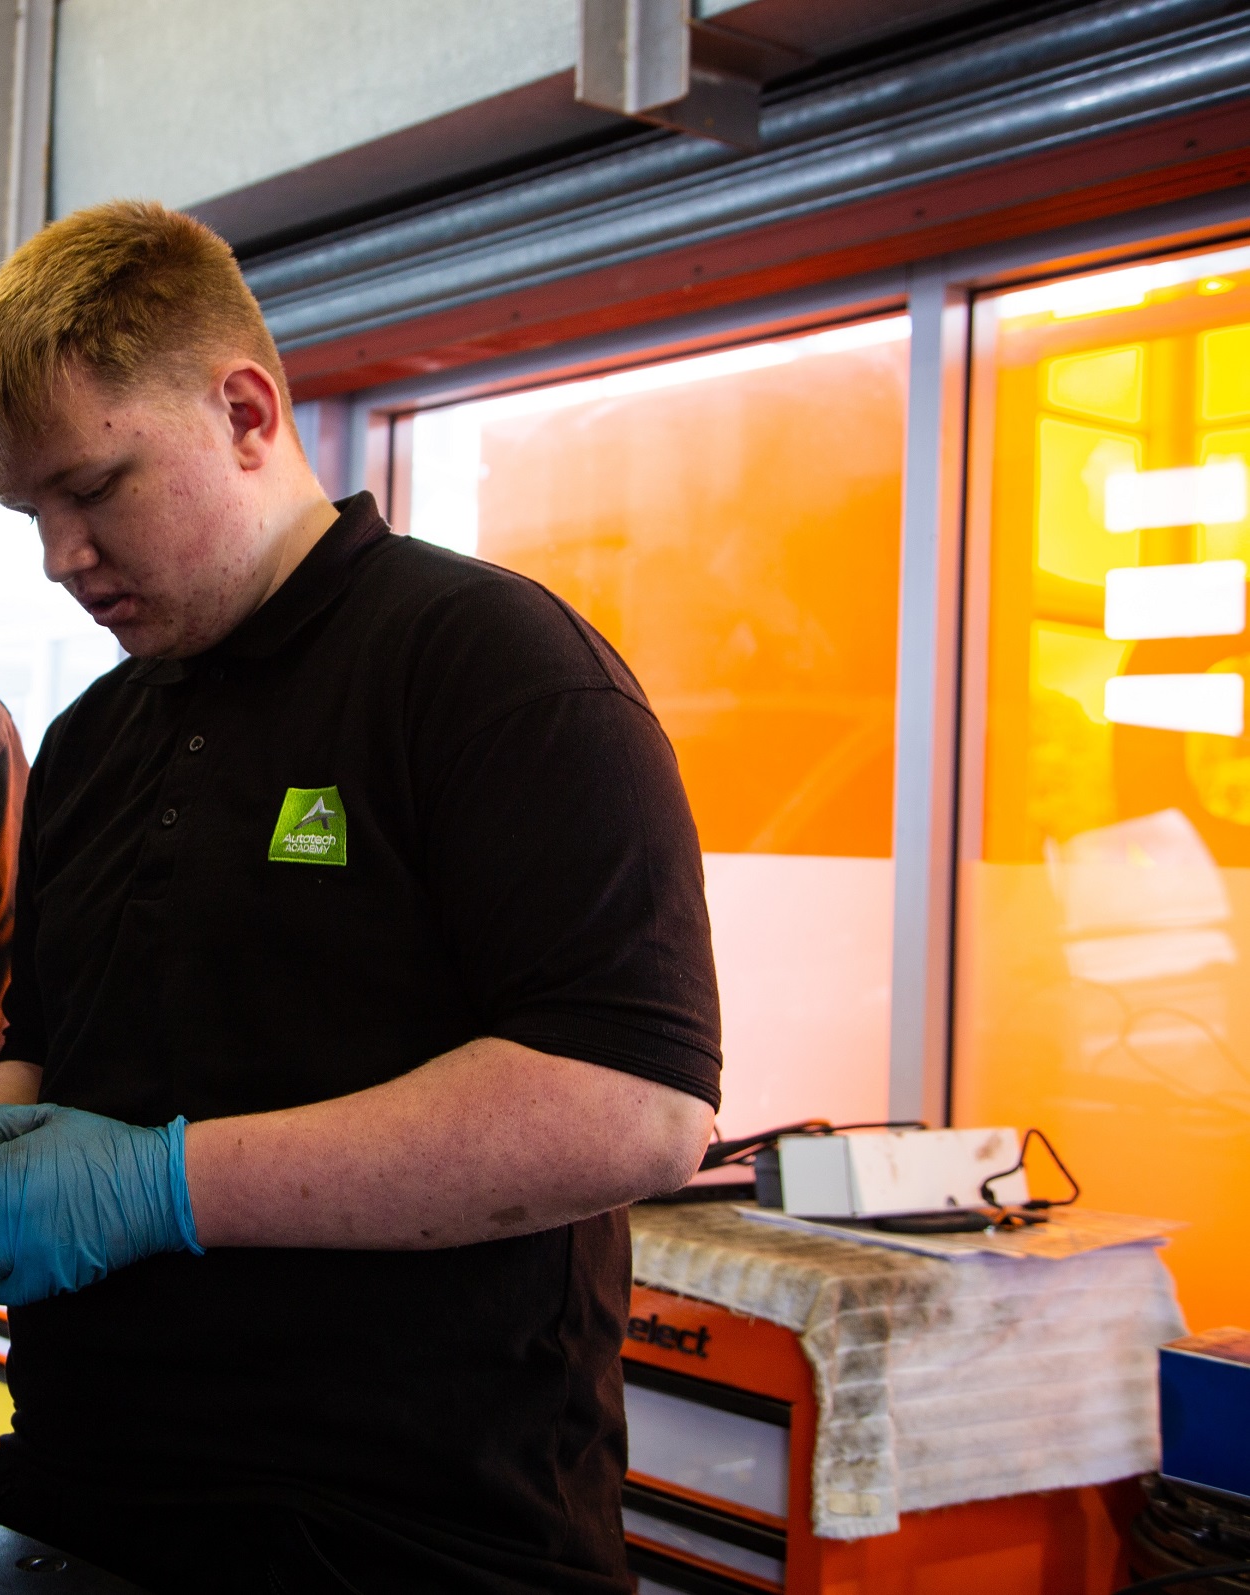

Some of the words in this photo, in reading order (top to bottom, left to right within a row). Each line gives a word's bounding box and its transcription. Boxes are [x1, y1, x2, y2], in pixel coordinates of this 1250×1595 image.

[283, 832, 337, 846] Autotech
[285, 843, 331, 854] ACADEMY
[627, 1313, 712, 1359] elect
